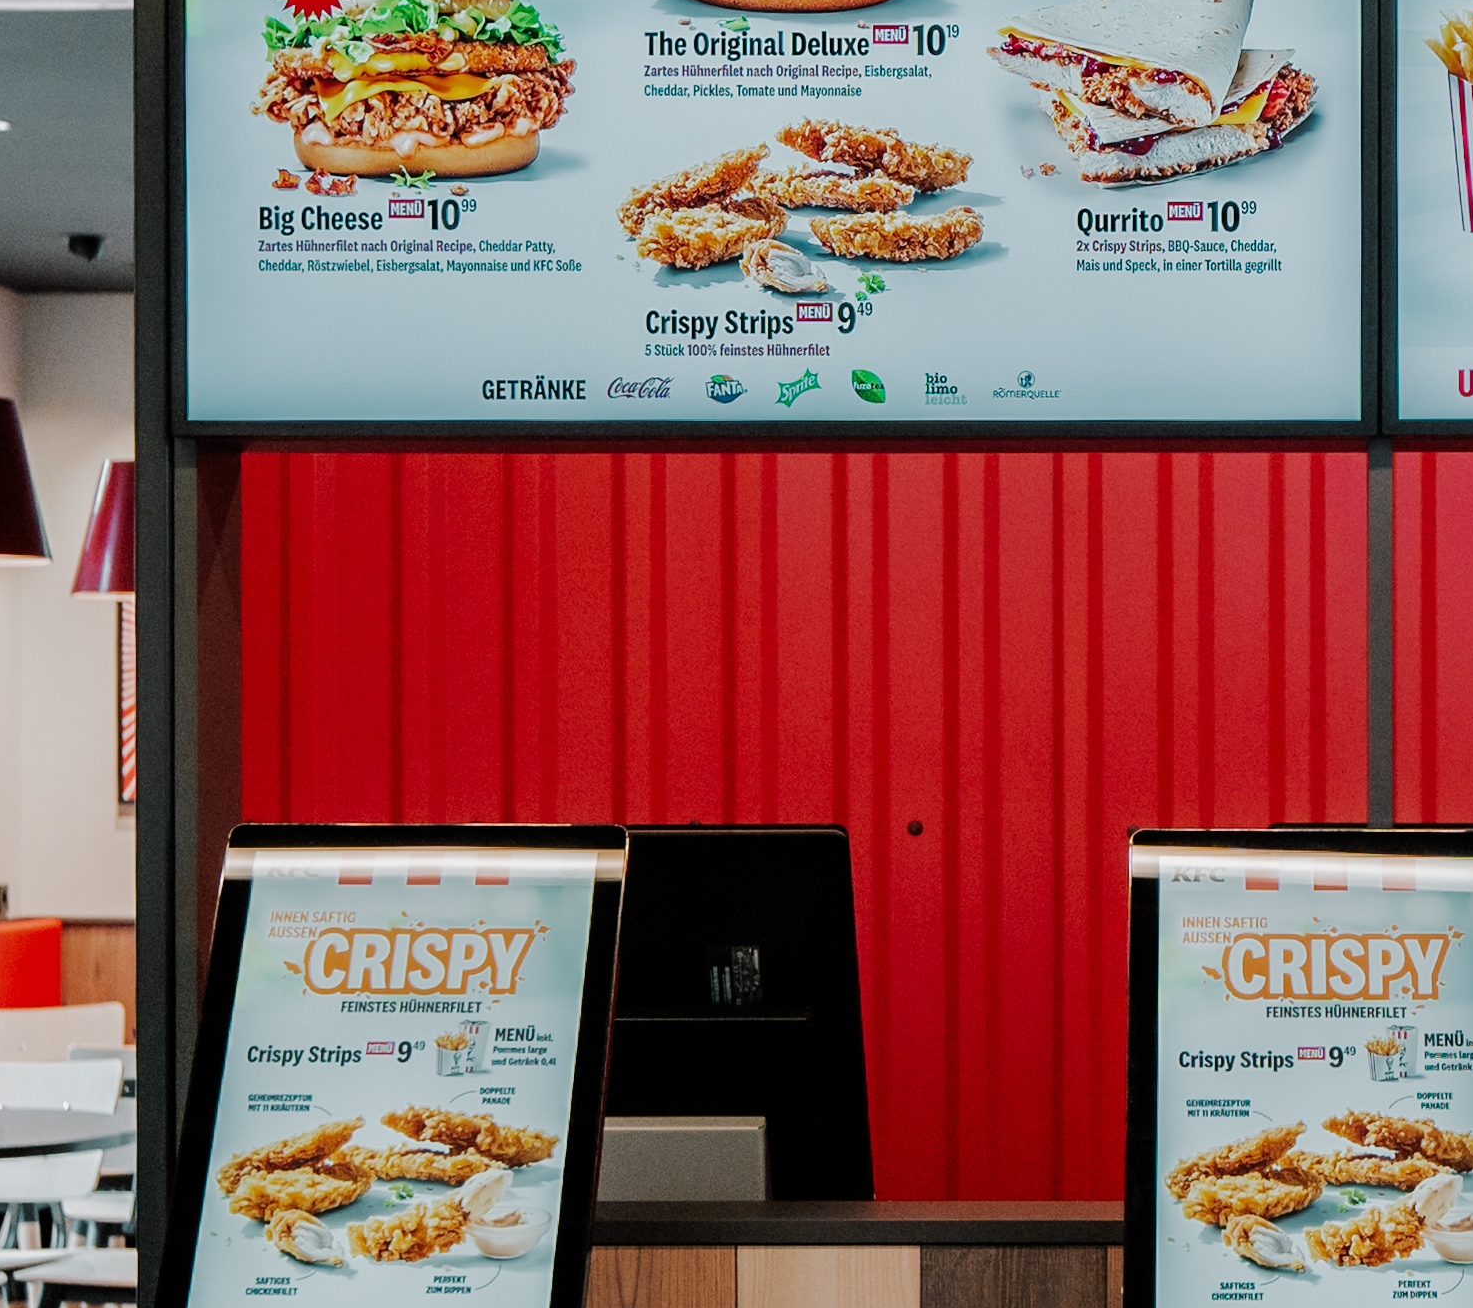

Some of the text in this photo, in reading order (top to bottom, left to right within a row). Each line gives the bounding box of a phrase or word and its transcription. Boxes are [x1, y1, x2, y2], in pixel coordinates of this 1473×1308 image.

[644, 30, 687, 56] The
[693, 28, 785, 62] Original
[791, 30, 870, 57] Deluxe
[875, 26, 907, 43] MENÜ
[643, 64, 932, 80] Zartes Hühnerfilet nach Original Recipe, Eisbergsalat,
[644, 83, 862, 100] Cheddar, Pickles, Tomate und Mayonnaise
[259, 205, 295, 236] Big
[301, 205, 383, 231] Cheese
[390, 201, 423, 217] MENÜ
[1077, 208, 1163, 235] Qurrito
[1168, 202, 1202, 219] MENÜ
[257, 239, 556, 256] Zartes Hühnerfilet nach Original Recipe, Cheddar Patty,
[1076, 239, 1277, 255] 2x Crispy Strips, BBQ-Sauce, Cheddar,
[258, 258, 583, 275] Cheddar, Röstzwiebel, Eisbergsalat, Mayonnaise und KFC Soße
[1076, 258, 1282, 275] Mais und Speck, in einer Tortilla gegrillt
[645, 309, 719, 340] Crispy
[724, 309, 794, 340] Strips
[798, 305, 831, 321] MENÜ
[644, 343, 831, 357] 5 Stück 100% feinstes Hühnerfilet
[482, 376, 586, 400] GETRÄNKE
[607, 377, 674, 399] Coca-Cola
[1172, 866, 1226, 883] KFC
[309, 929, 536, 994] CRISPY
[1226, 934, 1452, 1000] CRISPY
[340, 998, 483, 1014] FEINSTES HÜHNERFILET
[1266, 1003, 1407, 1019] FEINSTES HÜHNERFILET
[1424, 1031, 1464, 1048] MENÜ
[247, 1044, 305, 1067] Crispy
[307, 1045, 362, 1067] Strips
[1178, 1050, 1236, 1072] Crispy
[1240, 1050, 1294, 1073] Strips
